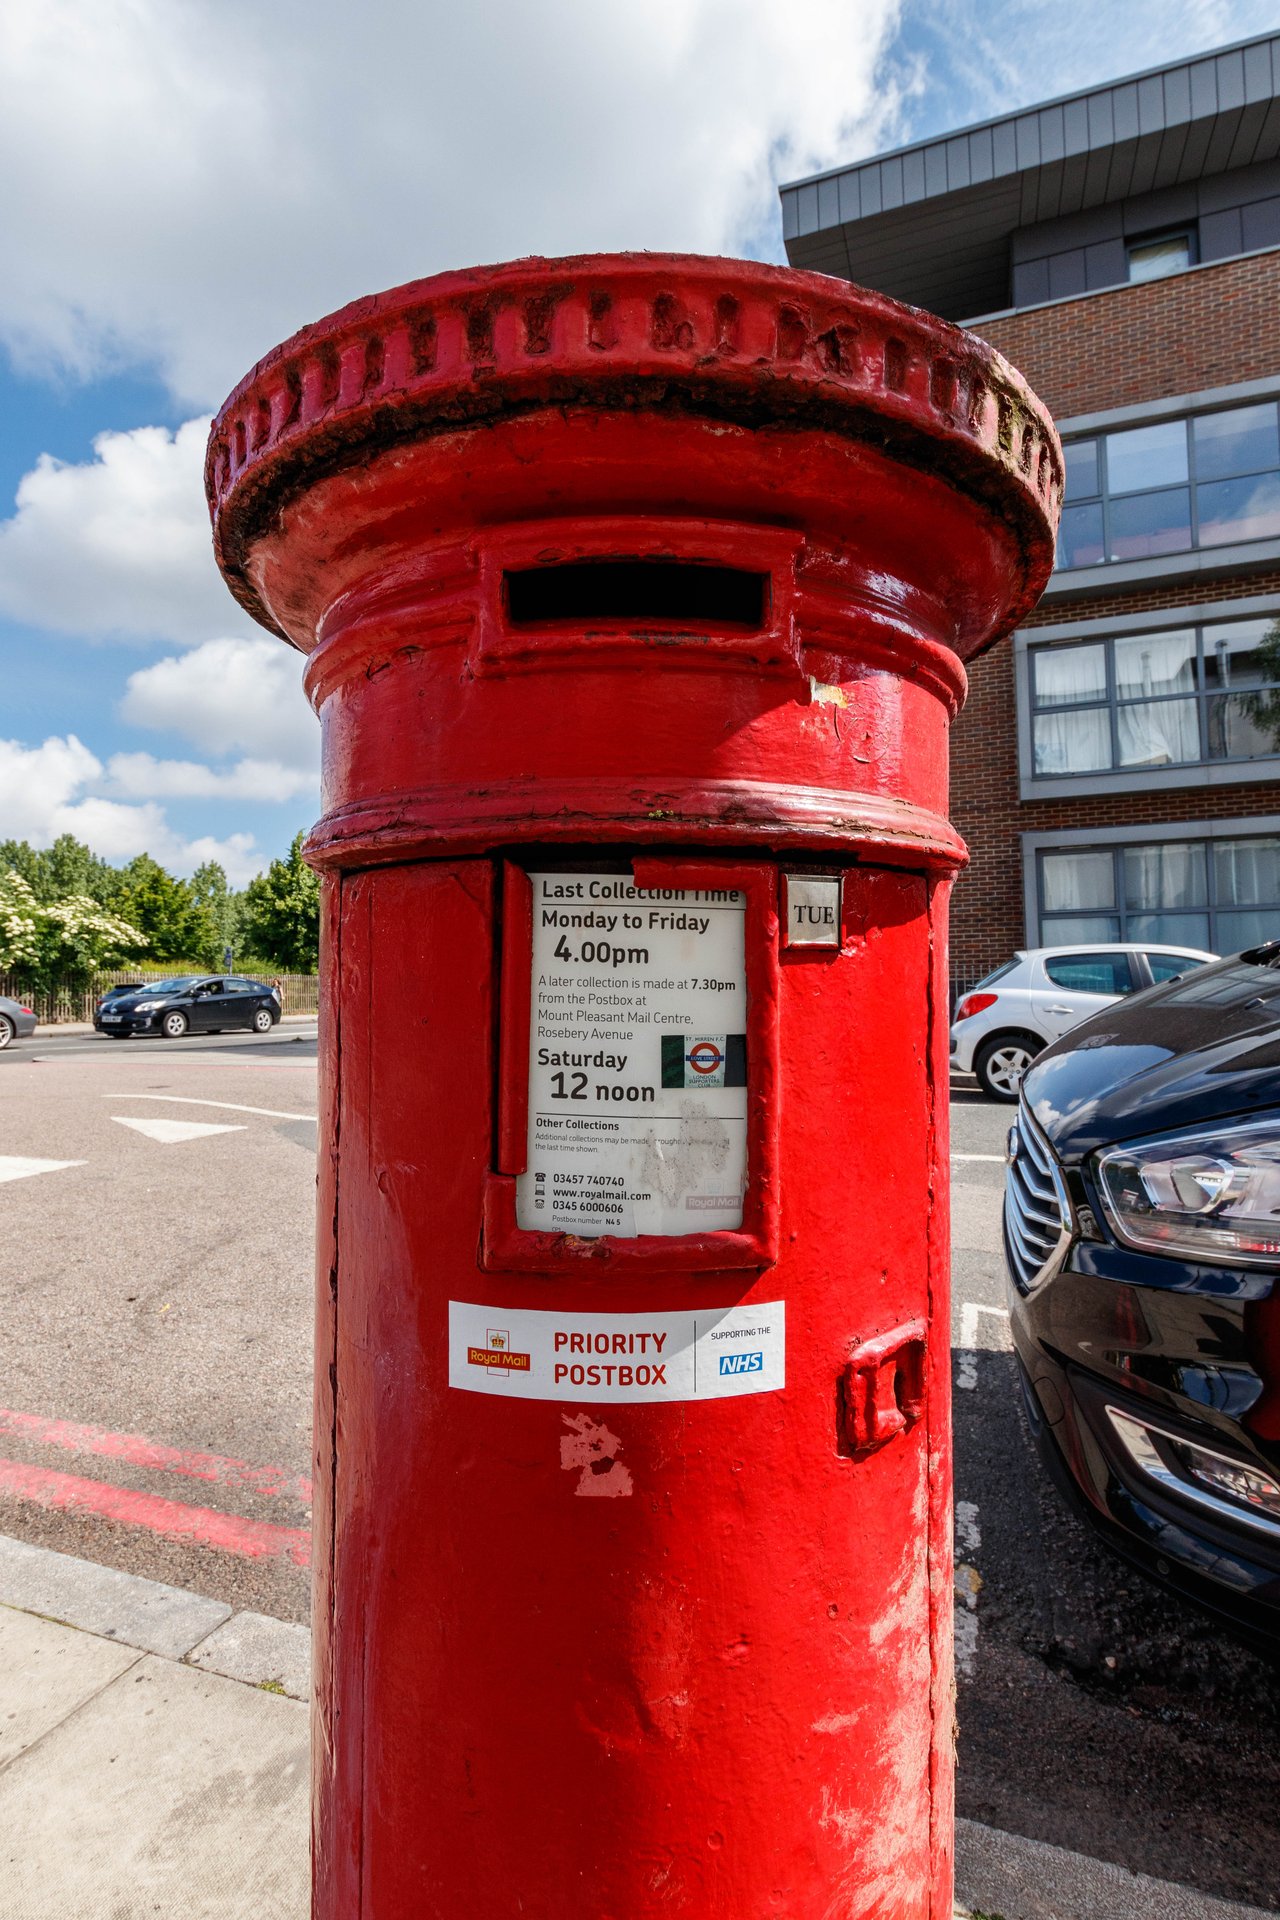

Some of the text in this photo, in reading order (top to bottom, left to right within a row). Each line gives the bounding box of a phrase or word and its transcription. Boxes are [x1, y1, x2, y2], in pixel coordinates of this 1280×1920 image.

[543, 881, 584, 898] Last
[589, 881, 685, 901] Collection
[793, 904, 835, 924] TUE
[542, 910, 710, 935] Monday to Friday
[554, 934, 650, 968] 4.00pm
[538, 976, 736, 993] A later collection is made at 7.30pm
[538, 992, 646, 1006] from the Postbox at
[538, 1009, 574, 1022] Mount
[576, 1010, 625, 1023] Pleasant
[627, 1011, 651, 1024] Mail
[538, 1026, 634, 1041] Rosebery Avenue
[538, 1048, 628, 1072] Saturday
[550, 1071, 655, 1102] 12 noon
[536, 1117, 620, 1131] Other Collections
[535, 1132, 568, 1142] Additional
[569, 1134, 604, 1144] collections
[605, 1136, 620, 1145] may
[535, 1143, 546, 1151] the
[547, 1143, 559, 1151] last
[560, 1144, 575, 1152] time
[553, 1173, 625, 1186] 03457 740740
[553, 1188, 651, 1201] www.royalmail.com
[553, 1200, 623, 1213] 0345 6000606
[552, 1214, 577, 1223] Postbox
[578, 1217, 602, 1225] number
[710, 1326, 771, 1341] SUPPORTING THE
[554, 1331, 668, 1355] PRIORITY
[470, 1350, 527, 1367] Royal Mail
[720, 1352, 762, 1375] NHS
[554, 1363, 667, 1387] POSTBOX
